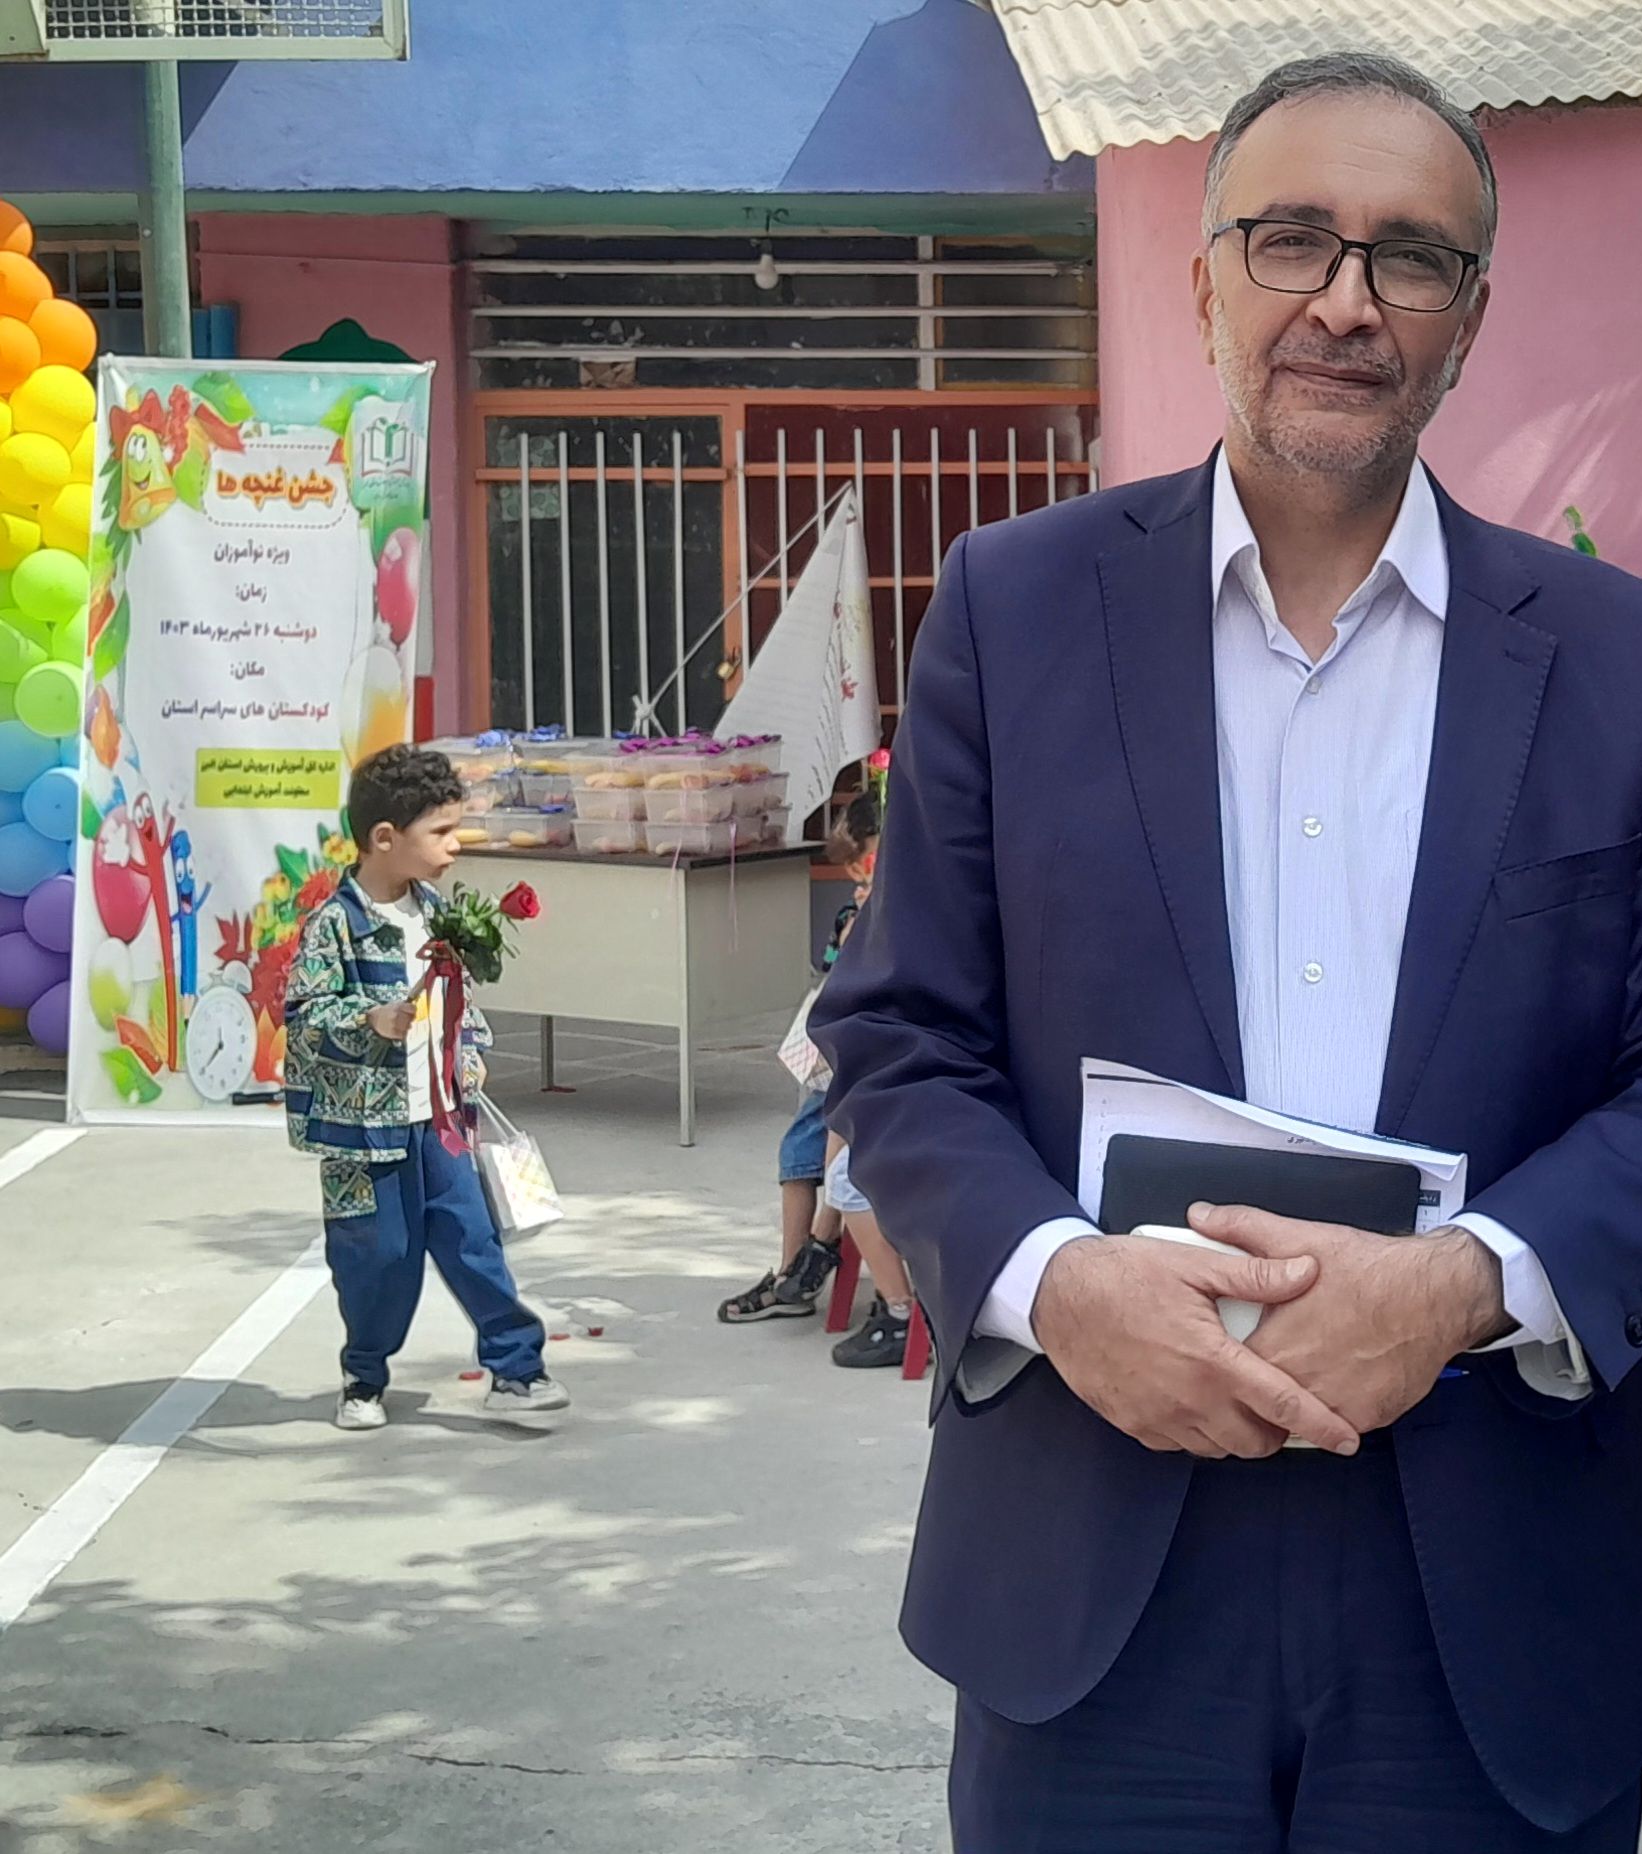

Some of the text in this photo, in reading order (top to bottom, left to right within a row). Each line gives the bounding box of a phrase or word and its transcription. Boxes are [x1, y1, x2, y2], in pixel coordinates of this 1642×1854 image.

[216, 466, 335, 511] جشن غنچه ها
[213, 538, 290, 565] ویژه نوآموزان
[235, 582, 267, 603] زمان:
[273, 621, 317, 644] دوشنبه
[229, 661, 265, 680] مکان:
[161, 699, 199, 719] استان
[200, 700, 238, 720] سراسر
[239, 701, 266, 720] های
